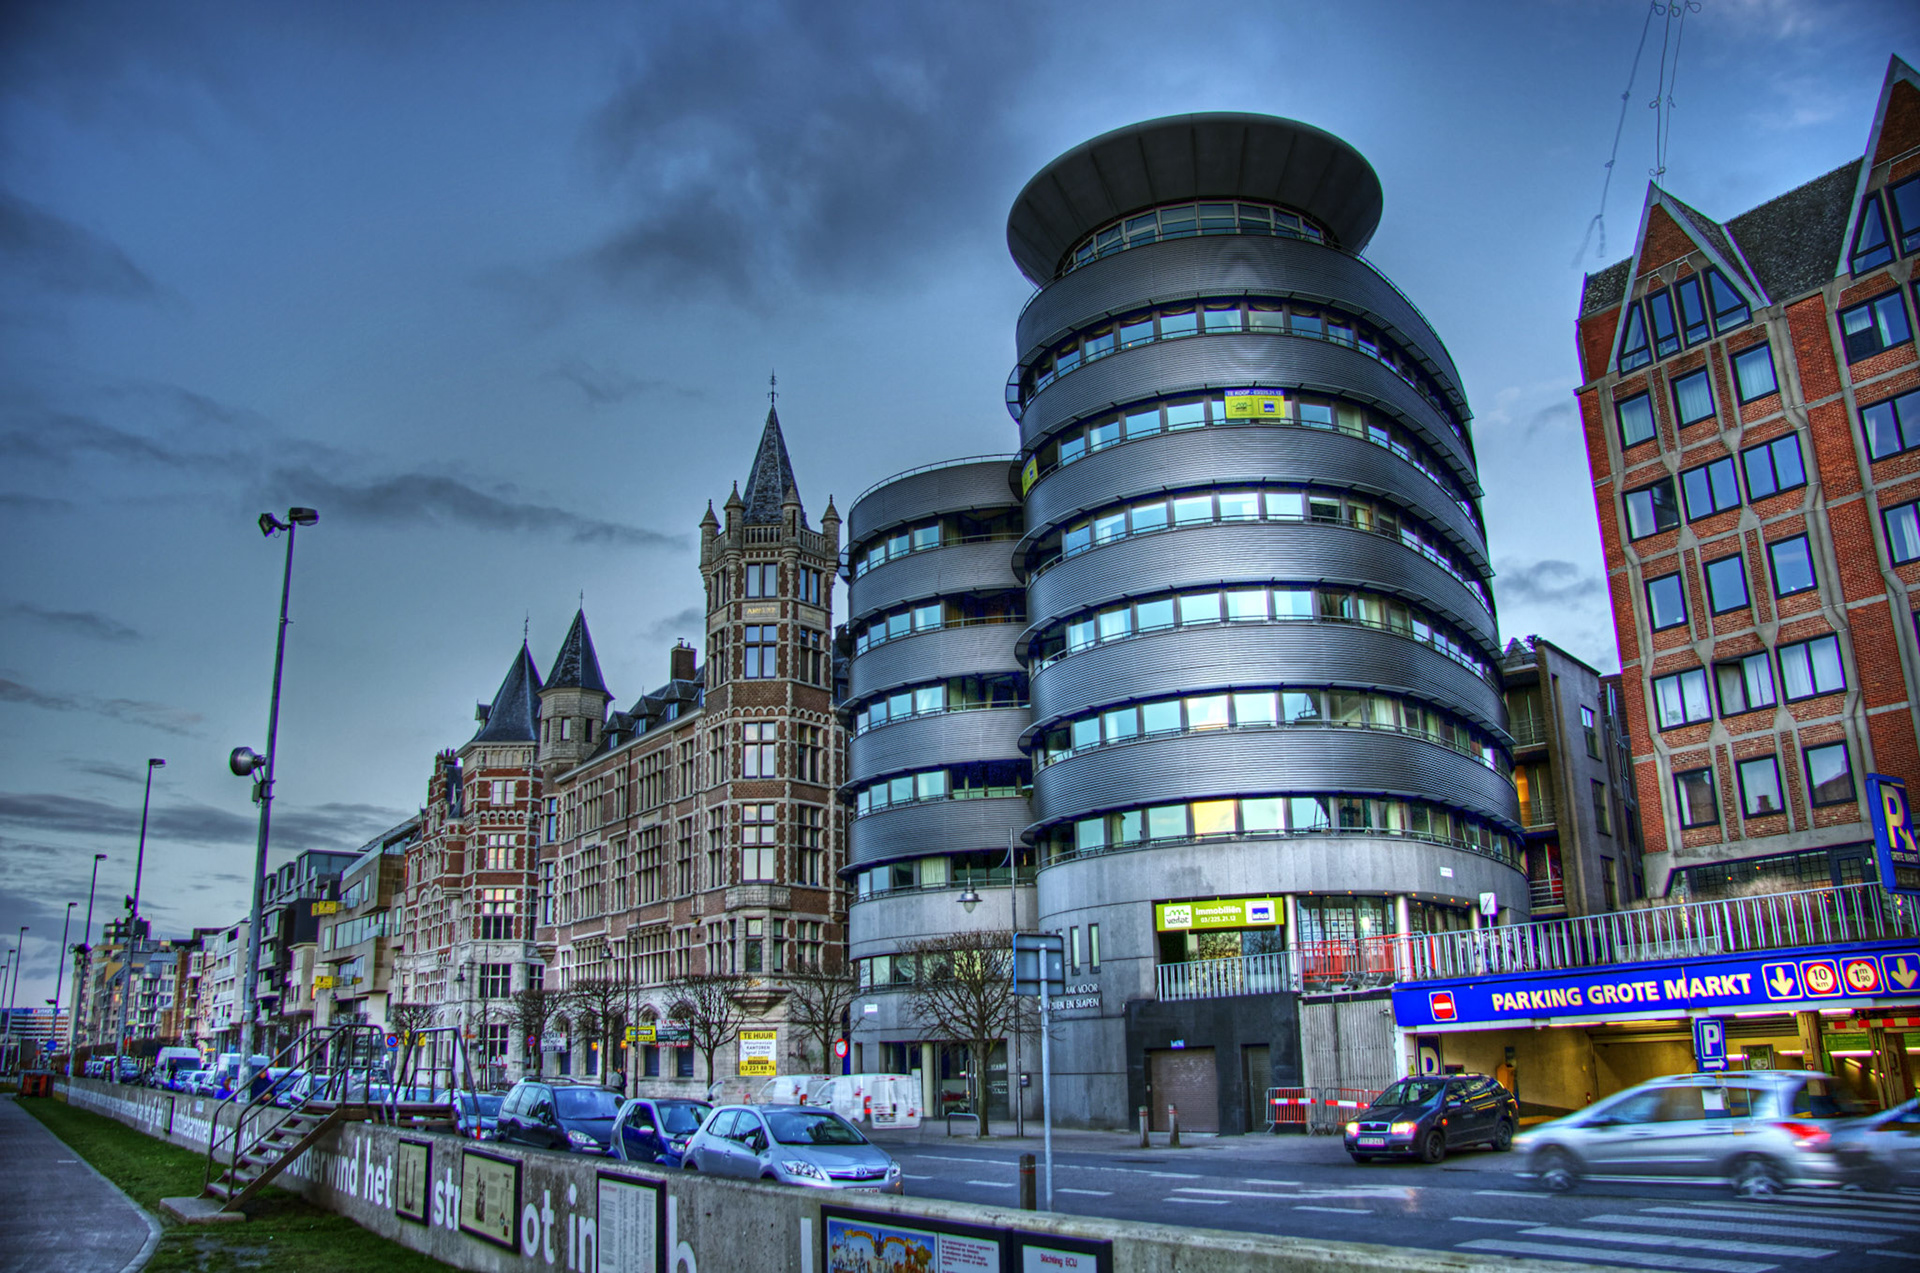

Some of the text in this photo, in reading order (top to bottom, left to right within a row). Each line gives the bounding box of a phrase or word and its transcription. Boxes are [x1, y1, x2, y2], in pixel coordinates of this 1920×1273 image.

[1811, 968, 1827, 981] 10
[1491, 973, 1752, 1012] PARKING GROTE MARKT
[1703, 1024, 1720, 1056] P
[364, 1137, 393, 1209] het
[1040, 1253, 1078, 1268] Stichting ECU
